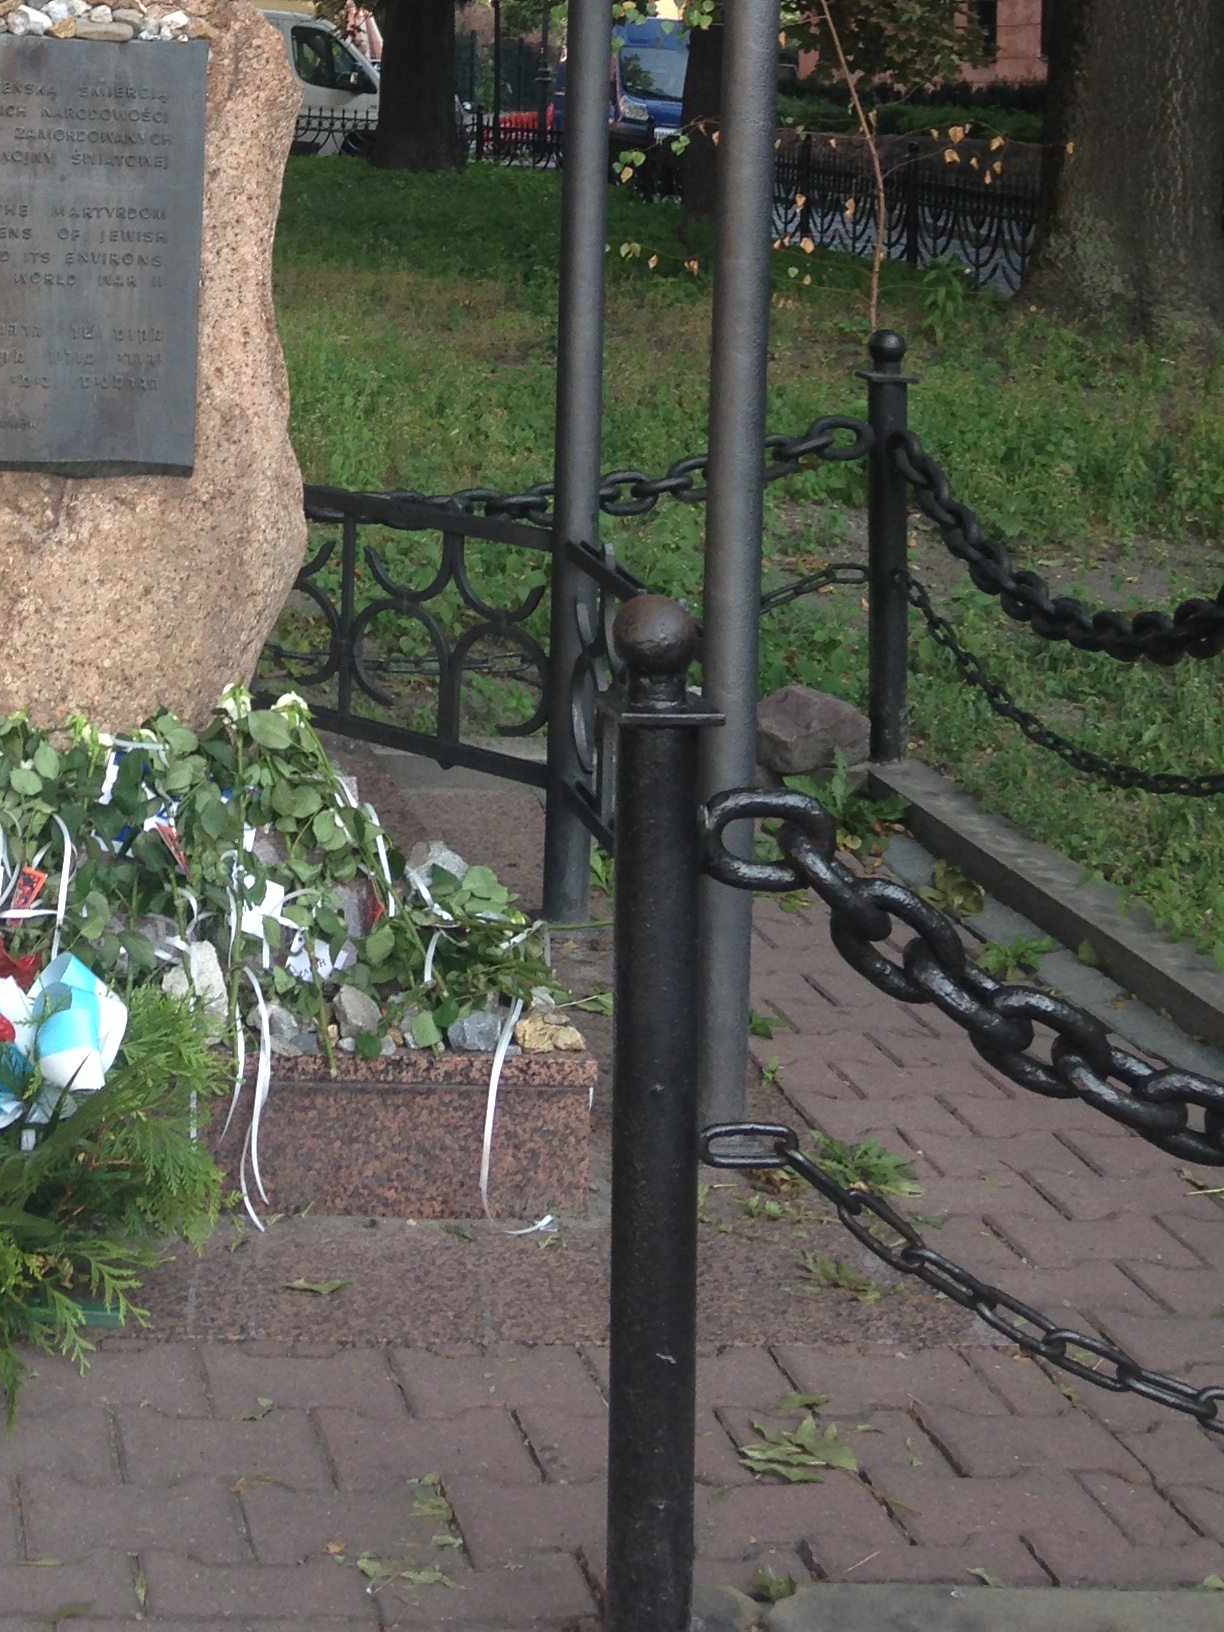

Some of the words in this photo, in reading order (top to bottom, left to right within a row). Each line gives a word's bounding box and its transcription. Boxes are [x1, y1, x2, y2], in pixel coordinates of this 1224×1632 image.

[15, 127, 173, 148] ZAMORDOWANYCH
[50, 205, 168, 222] MARTYRDOM
[57, 228, 81, 241] OF
[99, 230, 170, 246] JEWISH
[24, 250, 51, 263] ITS
[65, 250, 163, 268] ENVIRONS
[14, 272, 76, 287] WORLD
[99, 275, 138, 288] WAR
[152, 277, 161, 288] II
